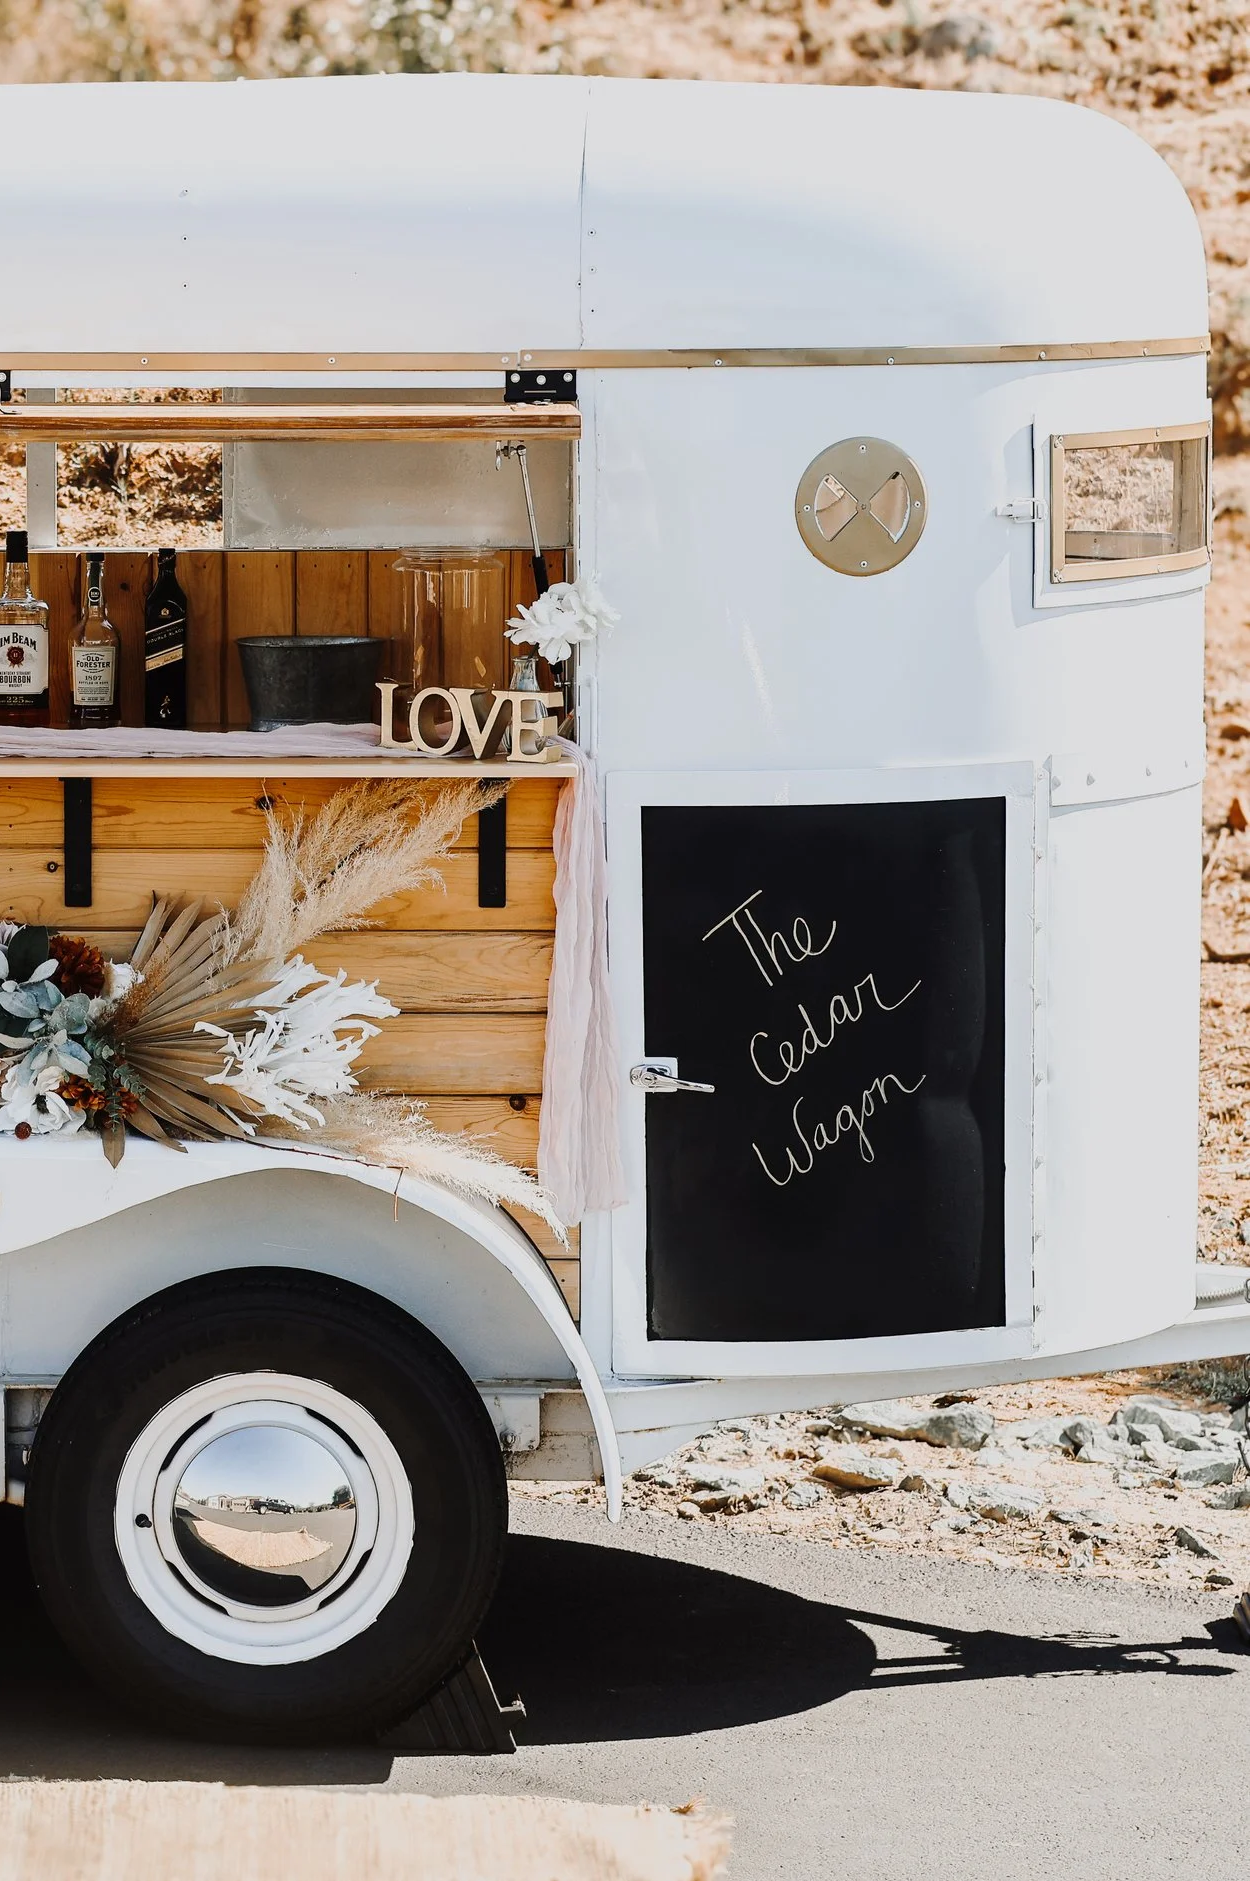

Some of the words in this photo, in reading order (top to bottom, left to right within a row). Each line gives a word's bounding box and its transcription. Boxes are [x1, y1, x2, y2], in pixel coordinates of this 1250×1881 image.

[0, 675, 31, 683] BOURBON
[11, 632, 38, 652] BEAM
[76, 660, 111, 668] FORESTER
[375, 681, 564, 764] LOVE
[702, 889, 837, 987] The
[749, 972, 922, 1086] Cedar
[752, 1073, 927, 1186] Wagon
